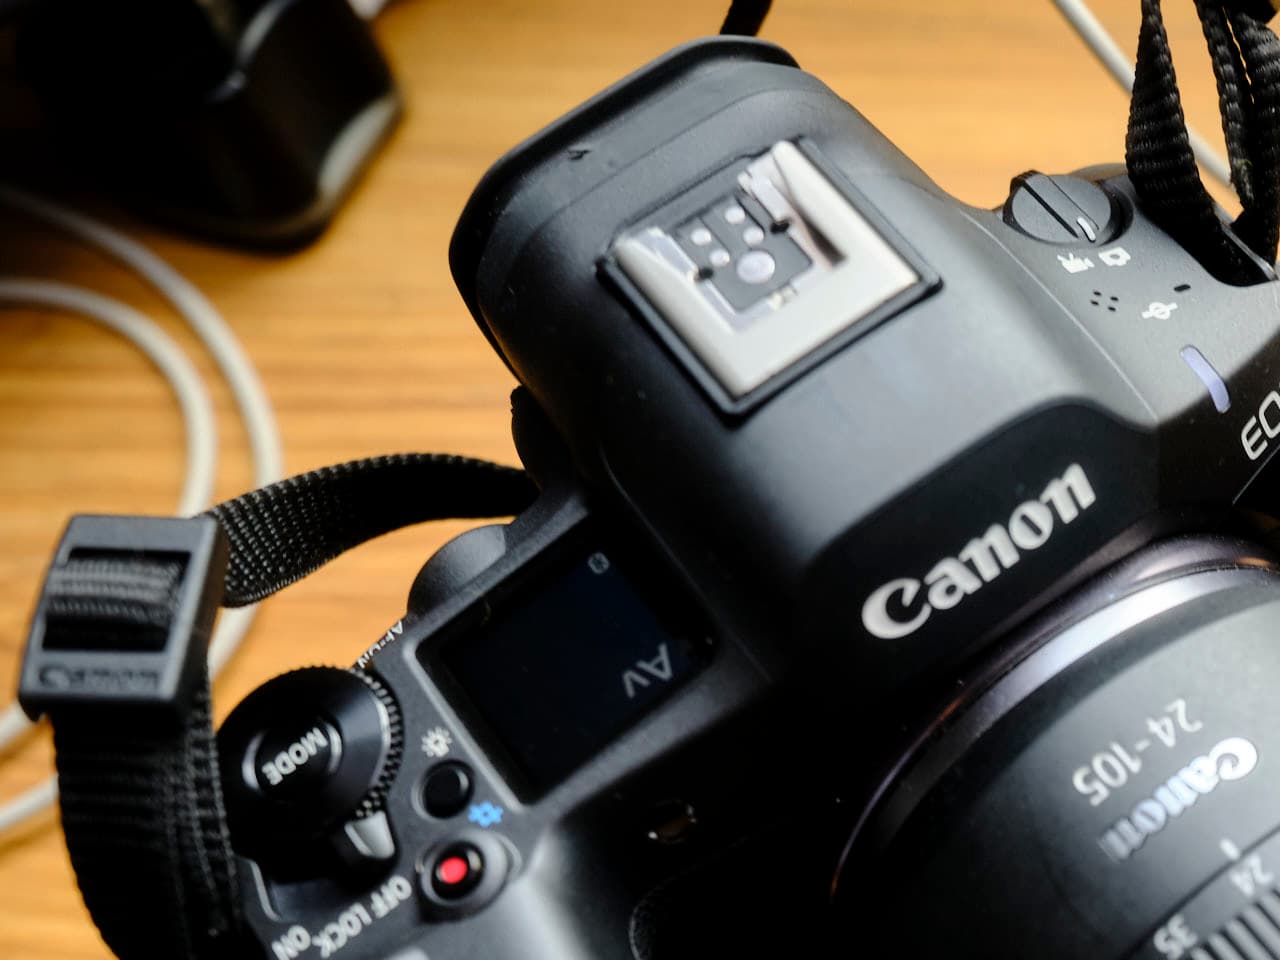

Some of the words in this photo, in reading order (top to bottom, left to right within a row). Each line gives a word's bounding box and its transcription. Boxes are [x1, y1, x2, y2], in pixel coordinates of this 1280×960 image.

[861, 462, 1096, 640] Canon
[261, 727, 328, 786] MODE
[1072, 698, 1203, 806] 24-105
[1099, 737, 1257, 863] Canon
[371, 875, 412, 919] OFF
[1230, 853, 1274, 896] 24
[312, 902, 373, 959] LOCK
